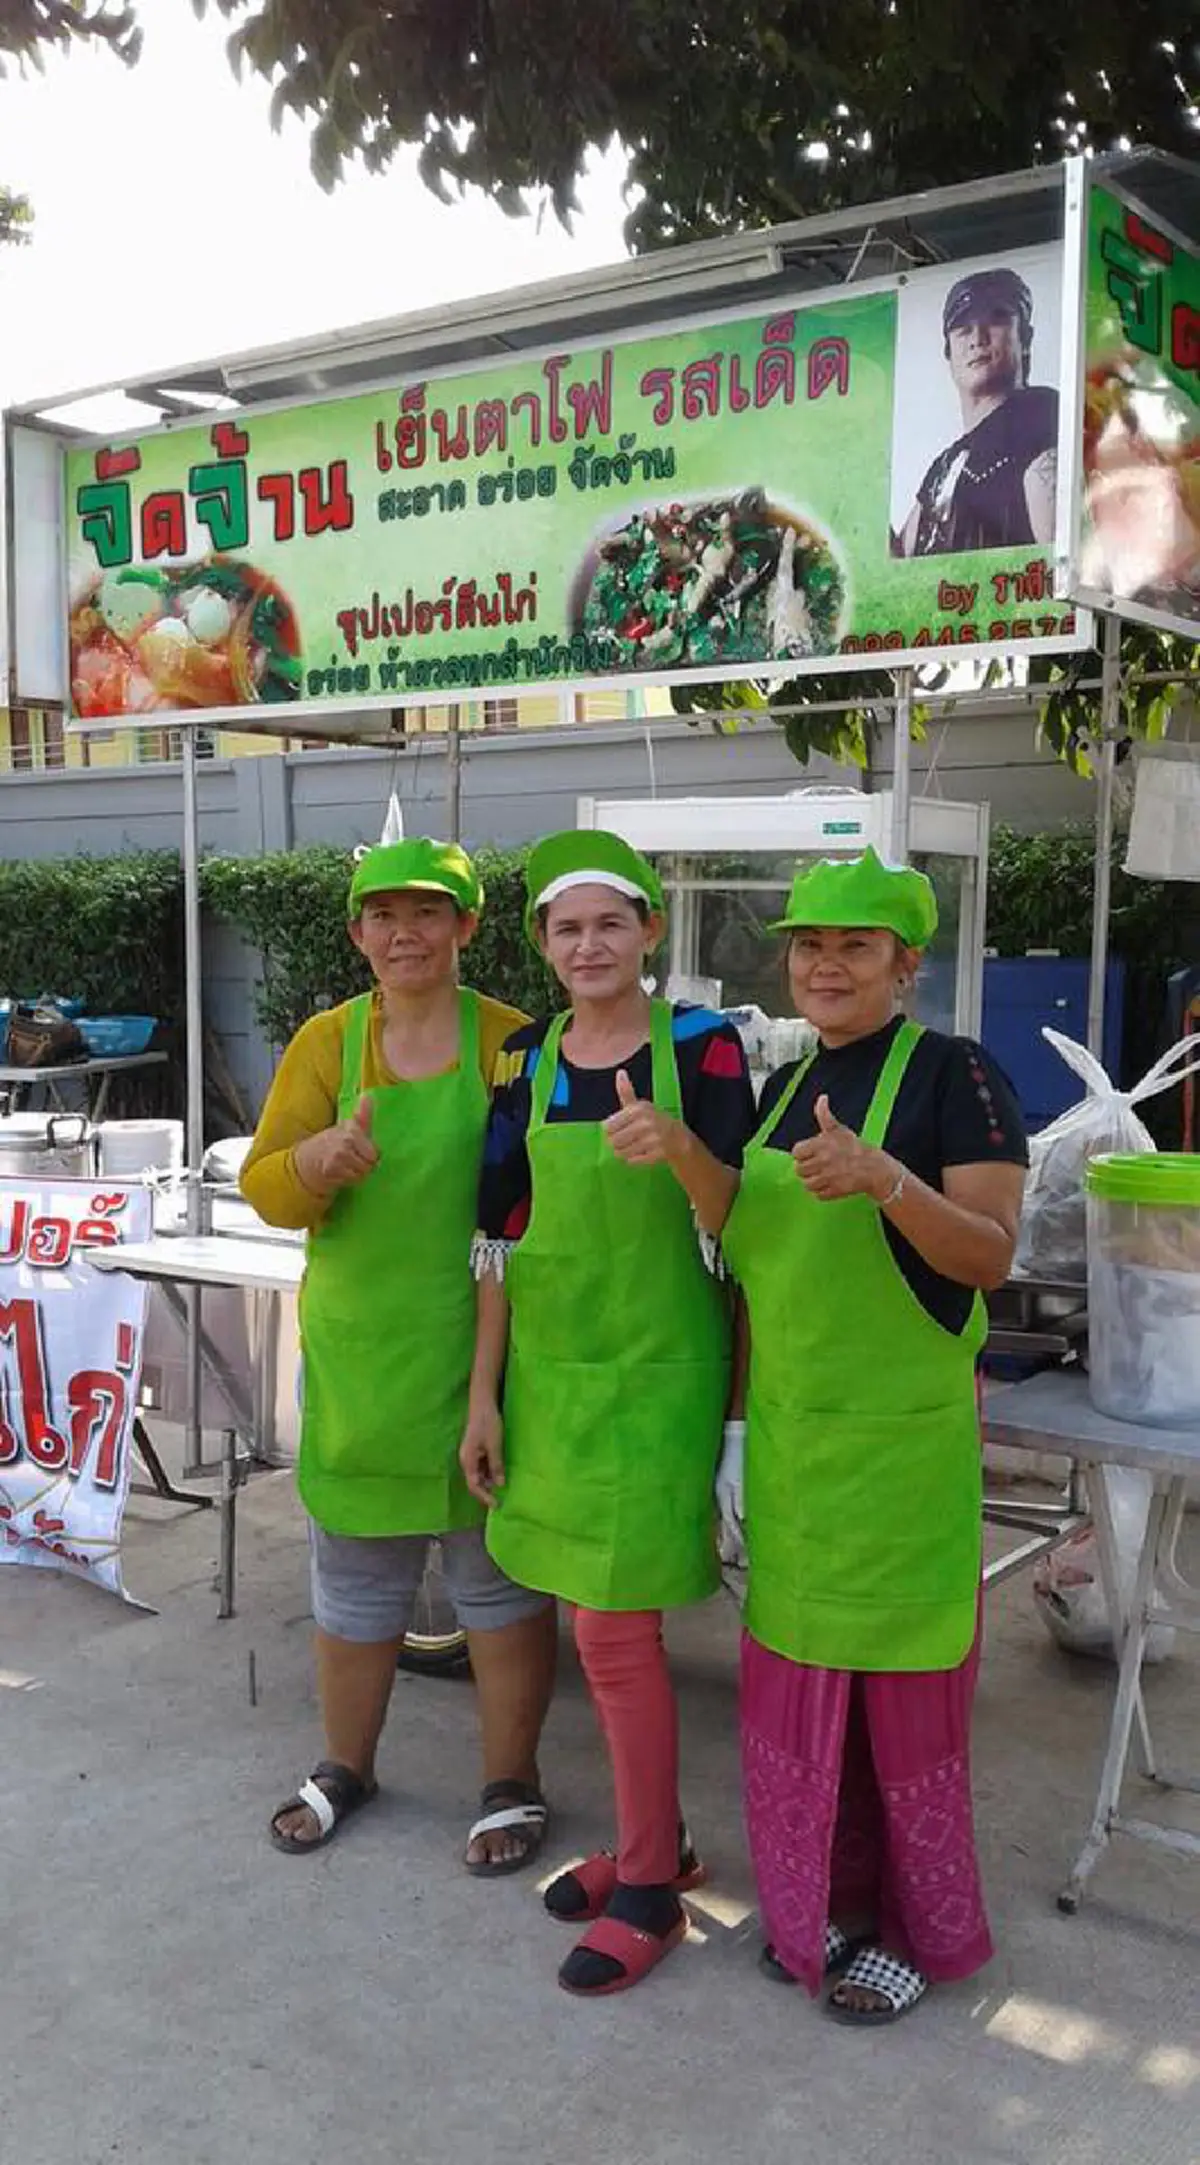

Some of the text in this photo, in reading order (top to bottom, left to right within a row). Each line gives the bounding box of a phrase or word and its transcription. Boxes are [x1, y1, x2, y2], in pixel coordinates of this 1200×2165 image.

[375, 312, 850, 472] เย็นตาโฟ รสเด็ด
[77, 422, 354, 568] จัดจ้าน
[378, 432, 676, 522] สะอาด อร่อย จัดจ้าน
[937, 579, 979, 616] by
[307, 653, 371, 696] อร่อย
